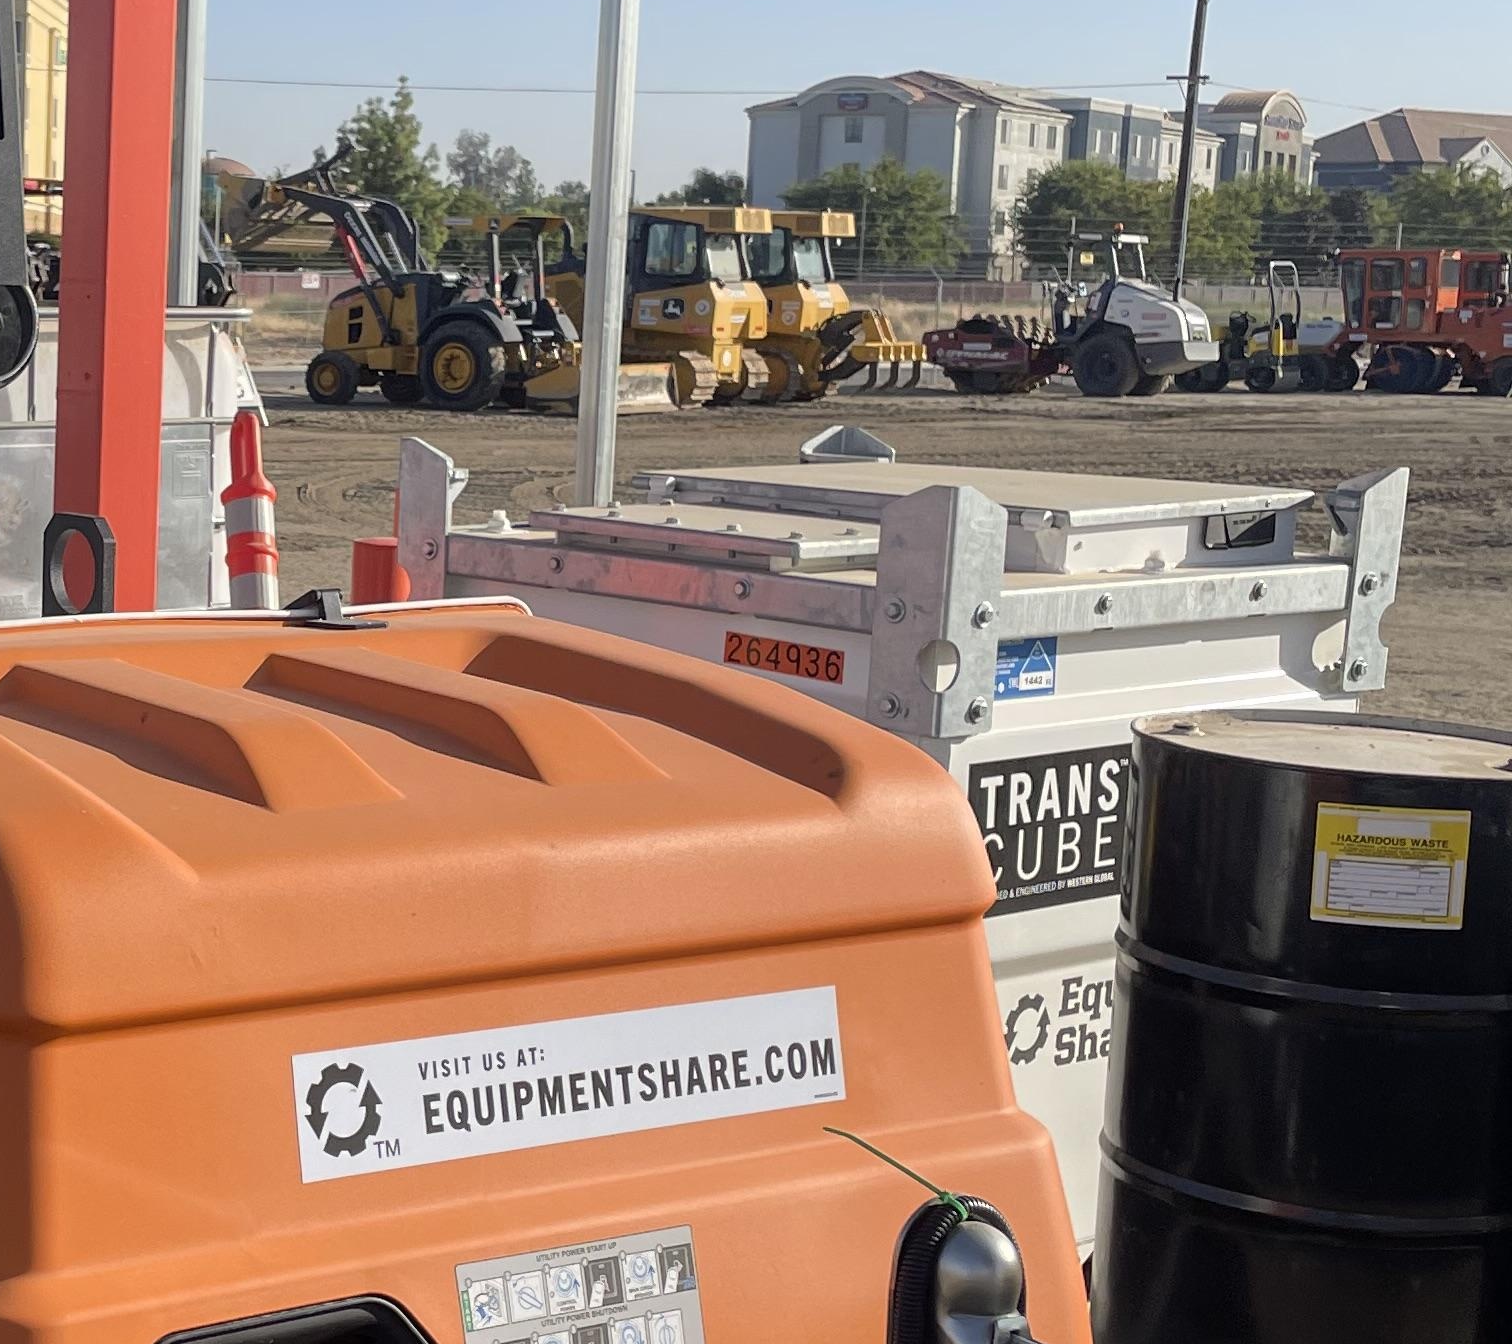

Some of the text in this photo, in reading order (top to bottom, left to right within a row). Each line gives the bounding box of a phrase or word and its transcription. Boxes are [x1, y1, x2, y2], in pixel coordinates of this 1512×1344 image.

[728, 635, 841, 681] 264936
[980, 759, 1121, 829] TRANS
[1336, 833, 1449, 849] HAZARDOUS WASTE
[1015, 881, 1057, 897] ENGINEERED
[1057, 880, 1066, 890] BY
[1067, 875, 1093, 888] WESTERN
[1094, 872, 1114, 884] GLOBAL
[418, 1047, 544, 1080] VISIT US AT:
[422, 1038, 836, 1134] EQUIPMENTSHARE.COM
[373, 1138, 401, 1158] TM
[561, 1247, 585, 1256] POWER
[587, 1244, 606, 1253] START
[608, 1242, 617, 1250] UP
[567, 1311, 591, 1321] POWER
[592, 1305, 627, 1317] SHUTDOWN
